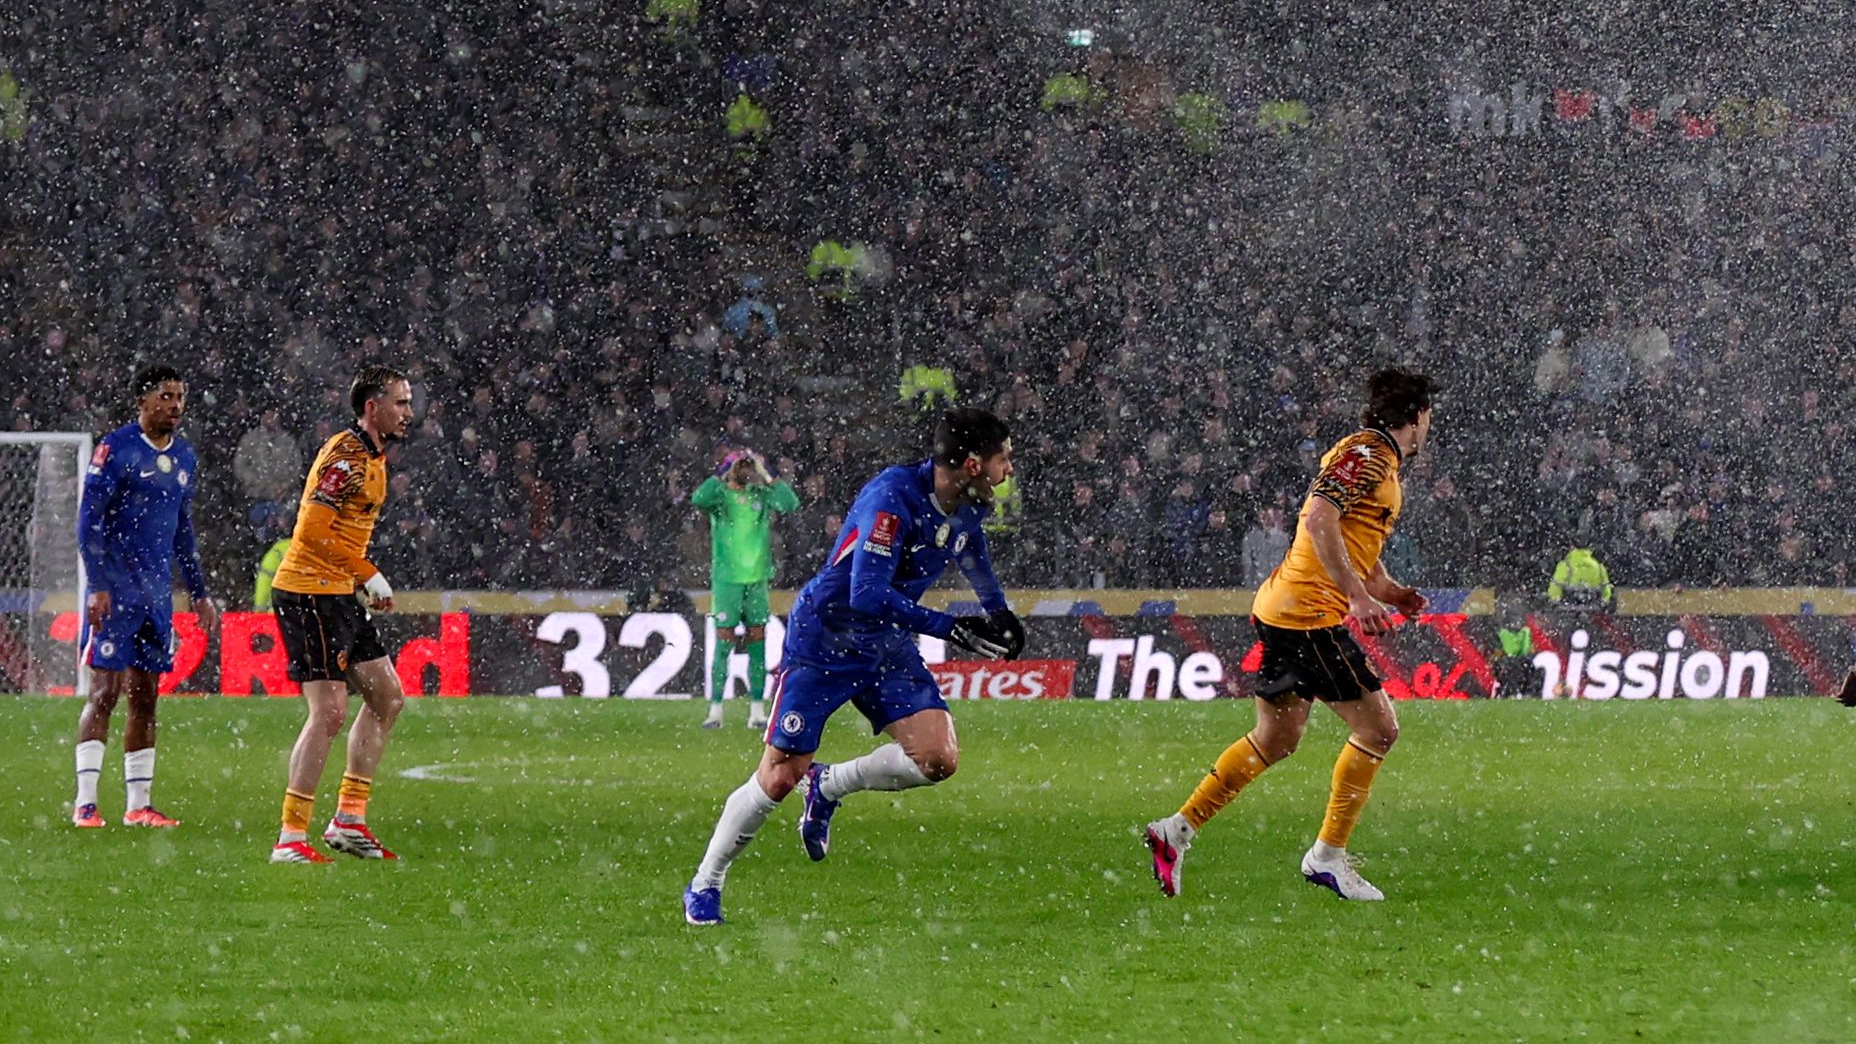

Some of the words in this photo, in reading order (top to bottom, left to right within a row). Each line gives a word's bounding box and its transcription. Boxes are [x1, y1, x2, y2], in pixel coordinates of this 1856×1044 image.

[48, 611, 470, 697] 2Rd
[932, 667, 1044, 700] ates
[1087, 635, 1223, 700] The
